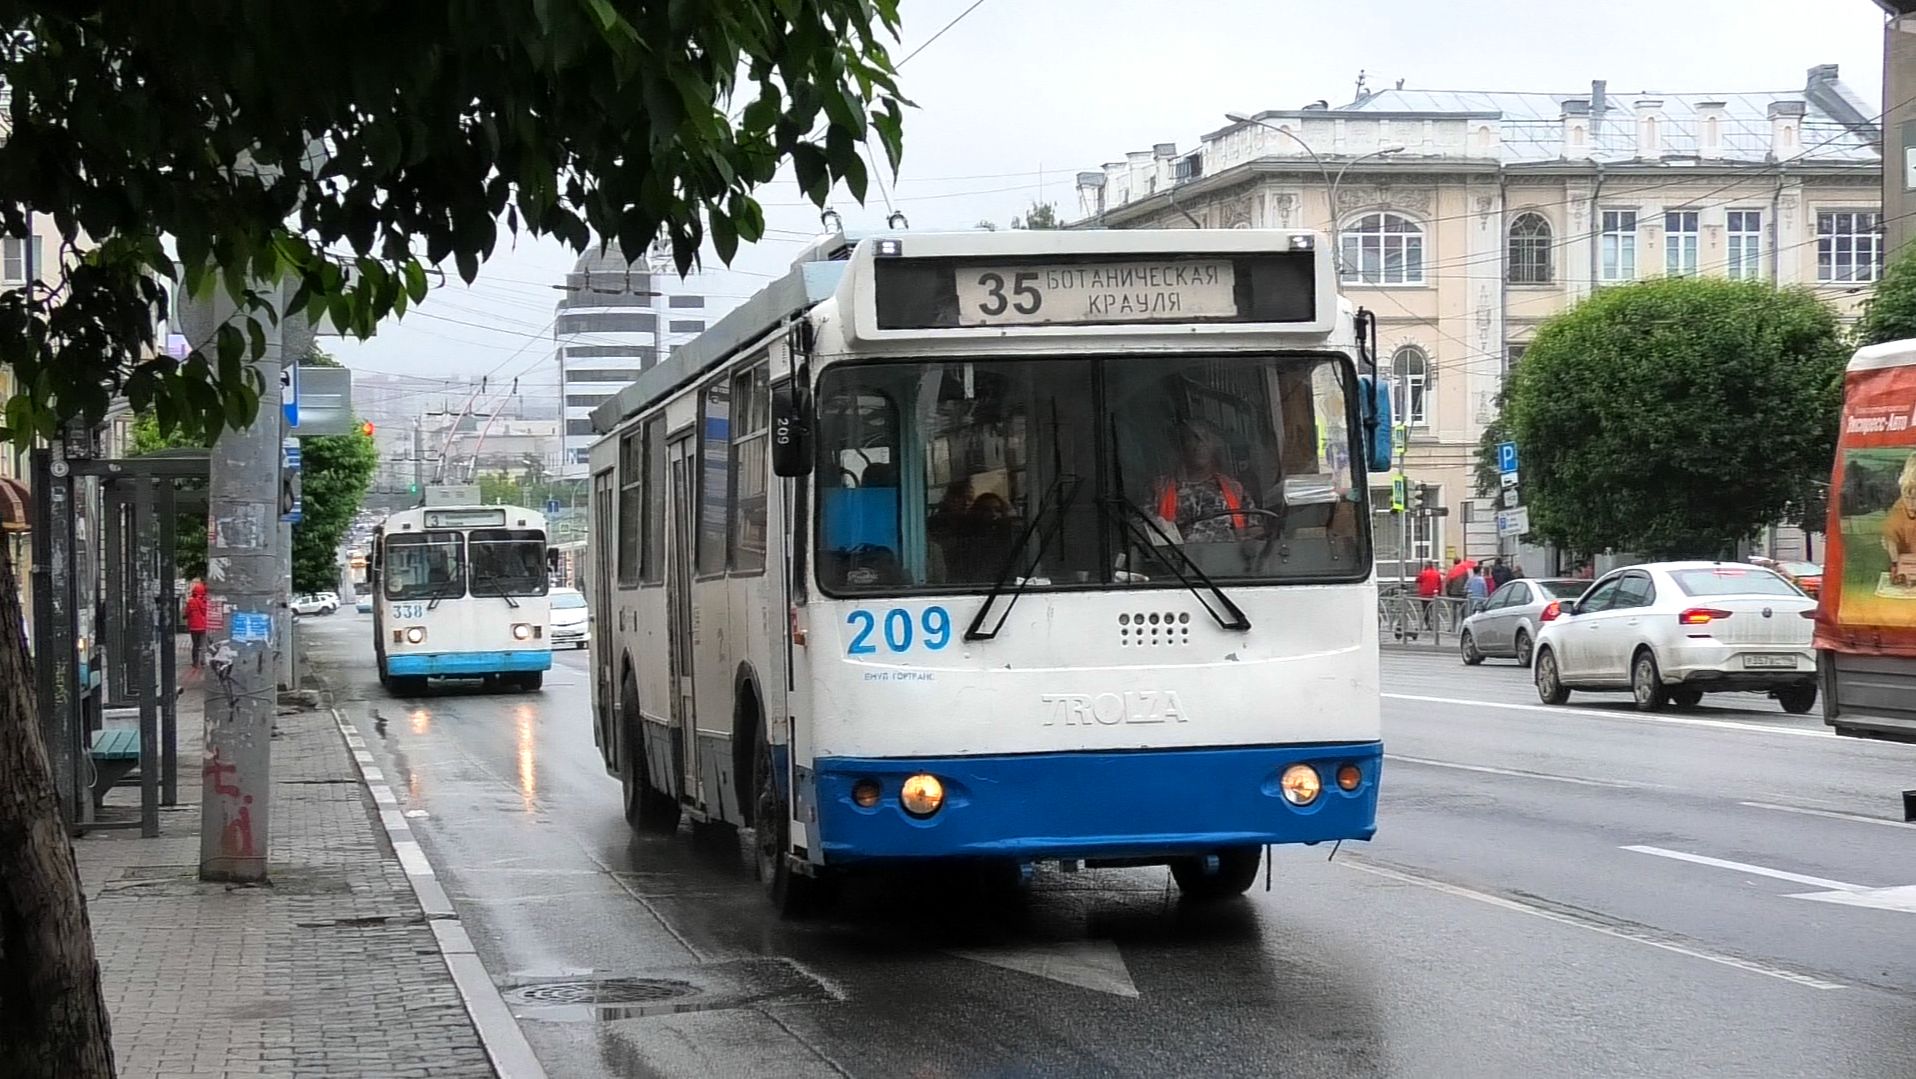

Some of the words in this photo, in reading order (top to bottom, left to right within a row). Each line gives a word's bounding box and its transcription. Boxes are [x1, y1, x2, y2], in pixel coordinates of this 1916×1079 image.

[1046, 265, 1219, 290] БОТАНИЧЕСКАЯ
[977, 272, 1042, 316] 35
[1088, 292, 1181, 314] КРАУЛЯ
[777, 417, 789, 445] 209
[1503, 446, 1514, 469] P
[393, 605, 423, 619] 338
[846, 605, 952, 655] 209
[1041, 690, 1190, 726] TROLZA
